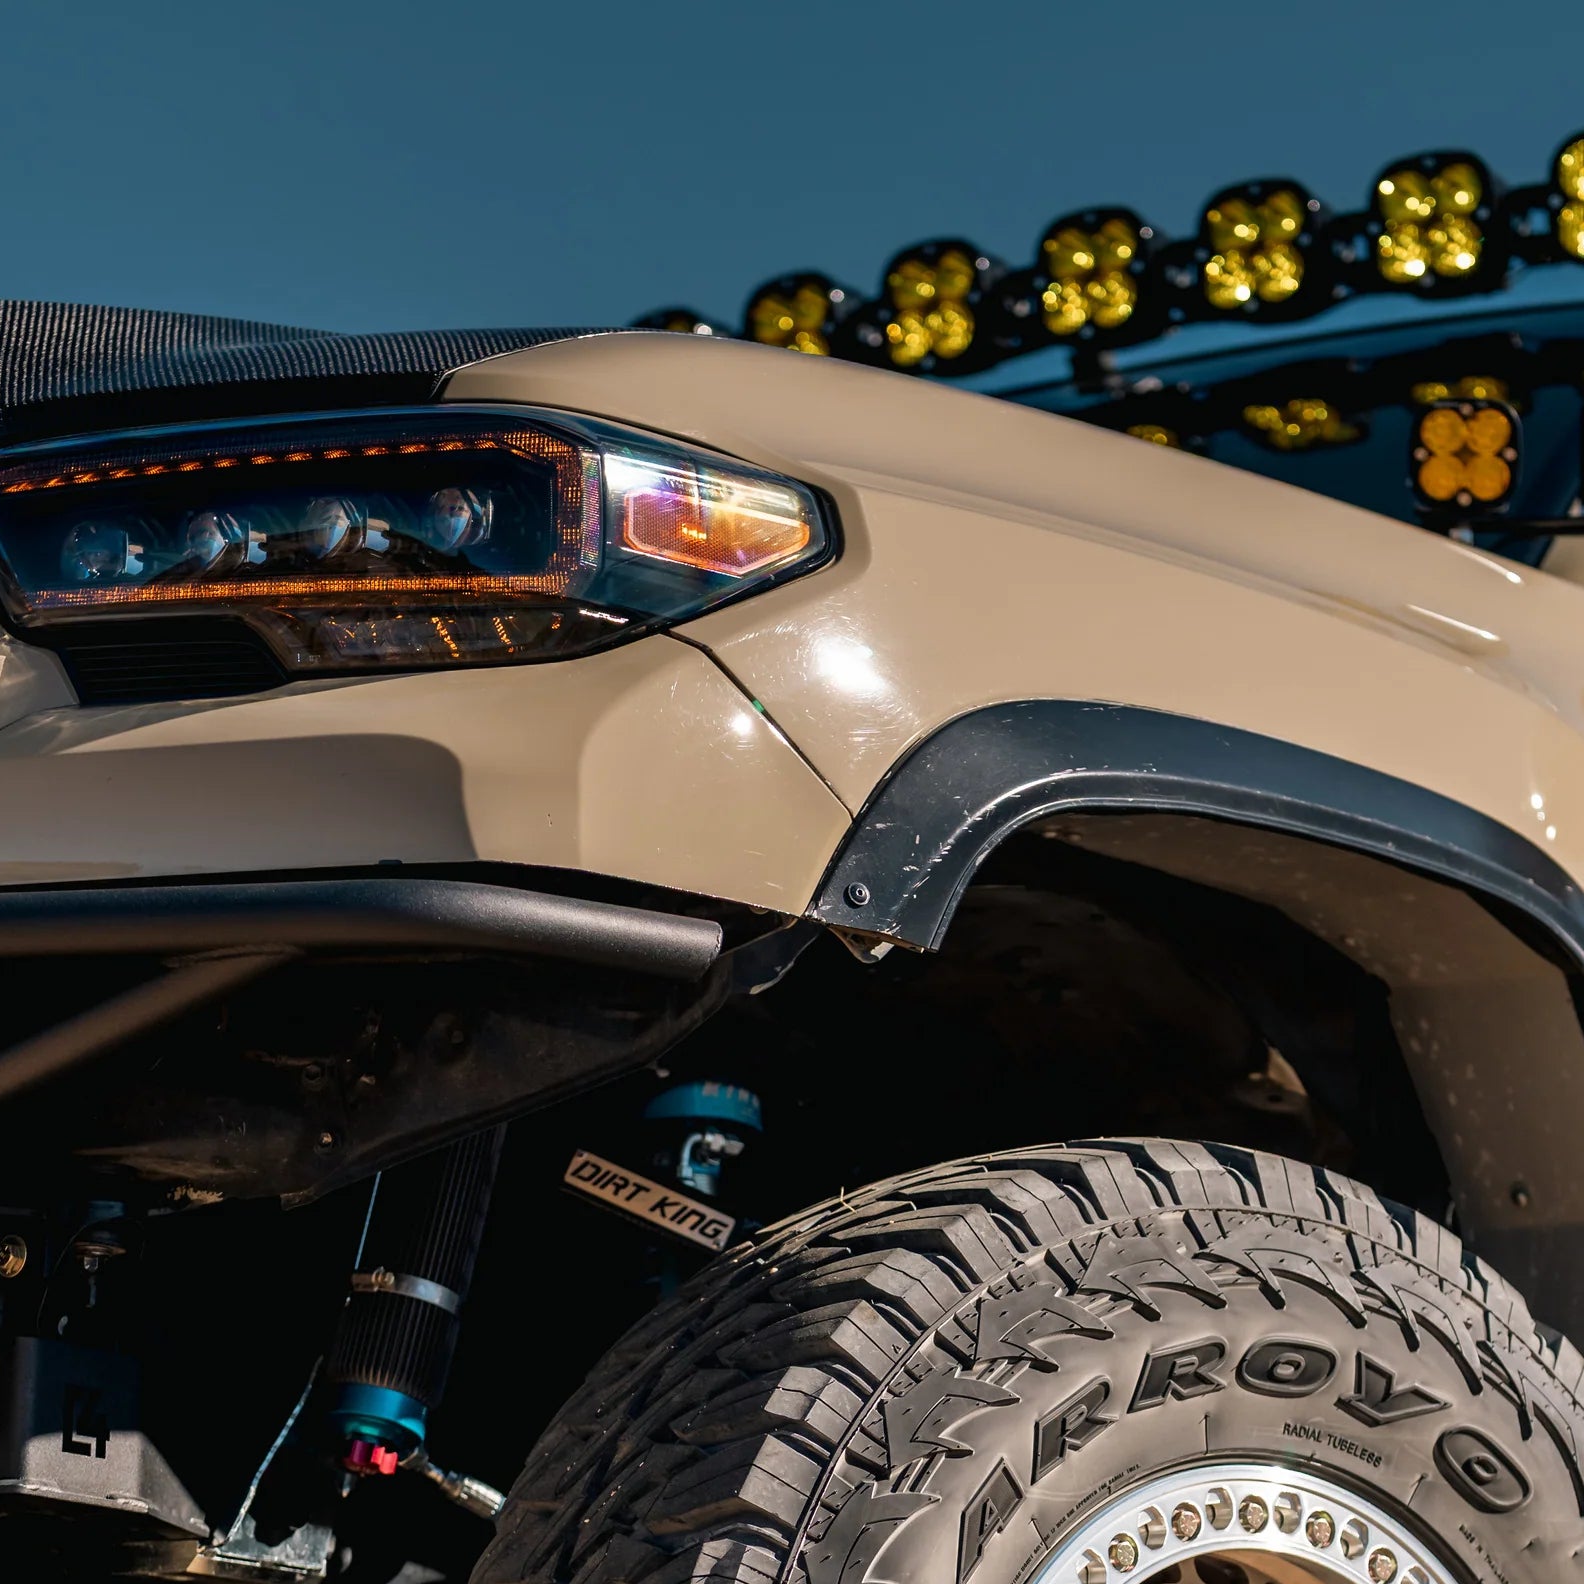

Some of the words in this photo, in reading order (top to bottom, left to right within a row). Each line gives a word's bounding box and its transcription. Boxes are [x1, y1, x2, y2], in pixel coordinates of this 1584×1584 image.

[570, 1160, 650, 1202] DIRT
[649, 1196, 728, 1240] KING
[1282, 1422, 1323, 1443] RADIAL
[1327, 1433, 1382, 1468] TUBELESS
